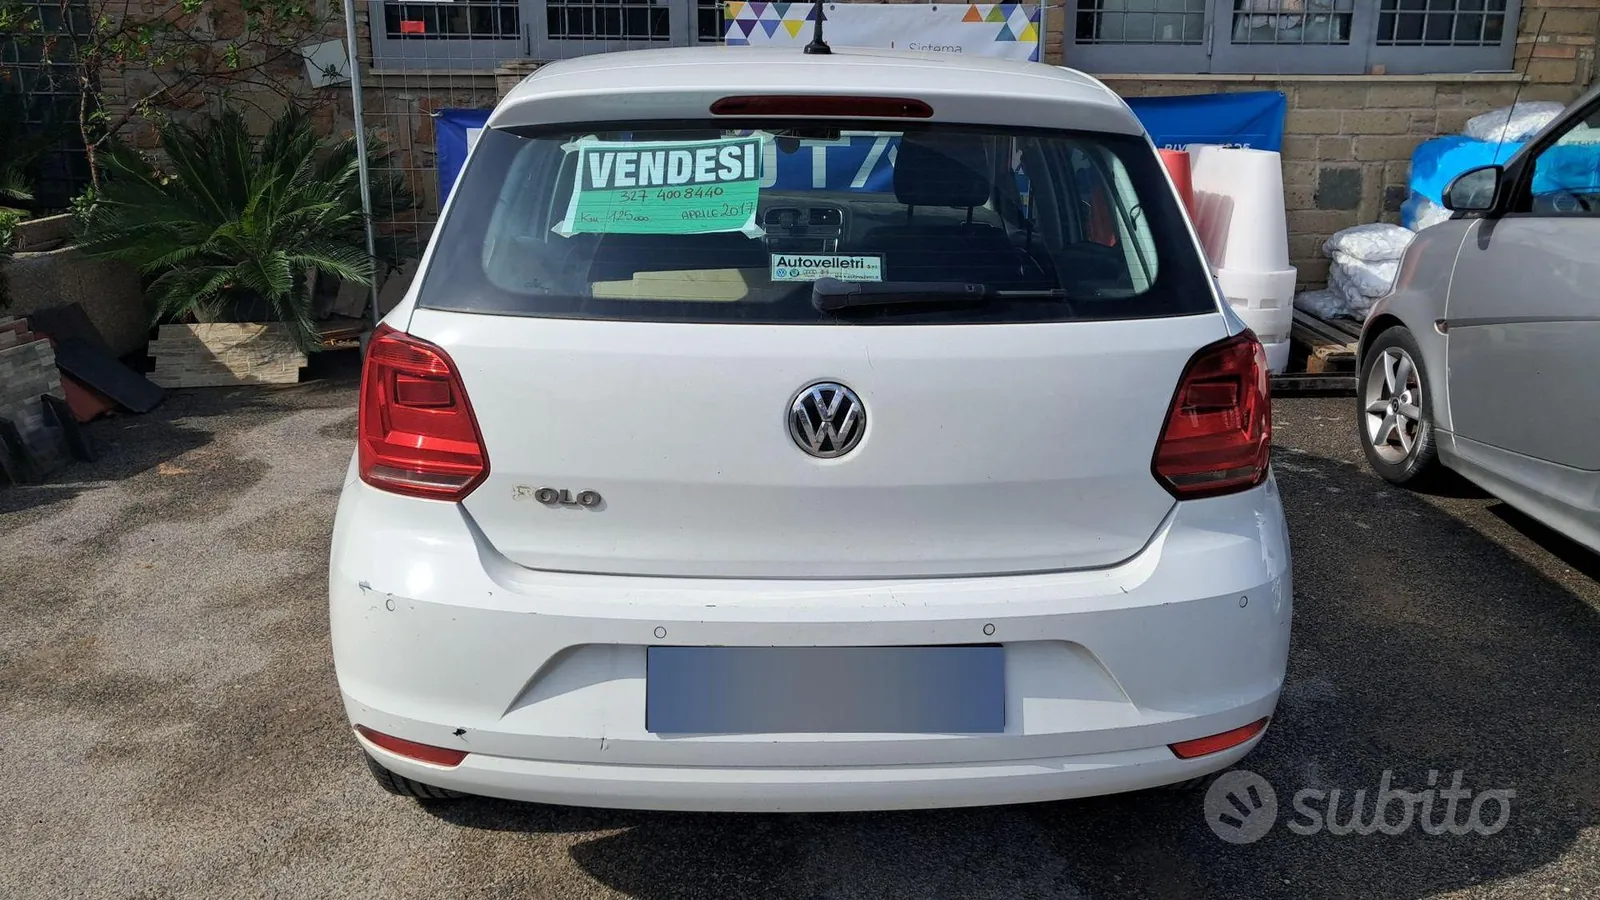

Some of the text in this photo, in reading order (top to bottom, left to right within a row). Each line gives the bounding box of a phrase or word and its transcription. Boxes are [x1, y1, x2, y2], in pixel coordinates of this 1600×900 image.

[589, 143, 755, 188] VENDESI
[620, 190, 648, 202] 327
[681, 209, 719, 219] APRILE
[720, 201, 754, 217] 2017
[776, 256, 864, 269] Autovelletri
